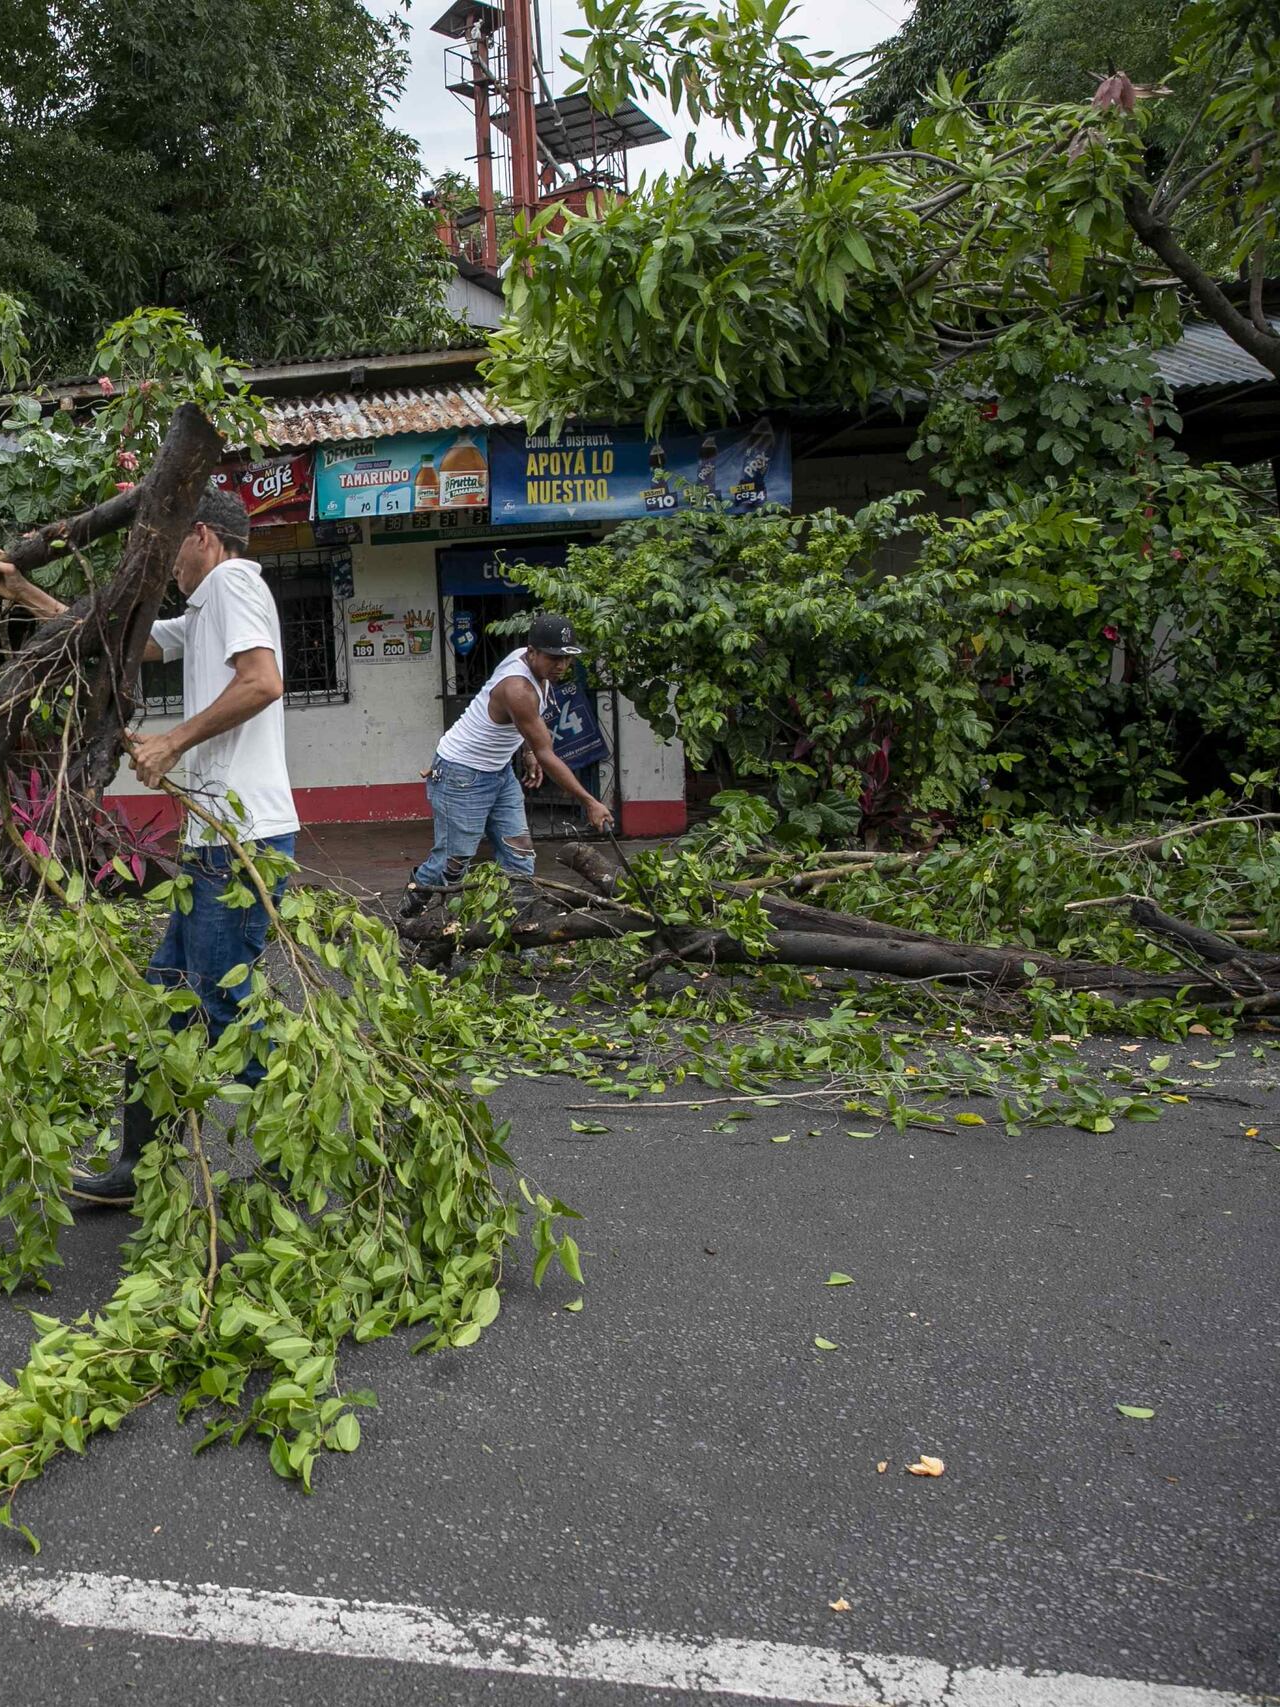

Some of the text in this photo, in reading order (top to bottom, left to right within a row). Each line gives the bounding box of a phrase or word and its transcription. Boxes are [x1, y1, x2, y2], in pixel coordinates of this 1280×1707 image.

[566, 433, 614, 447] DISFRUTÁ.
[526, 448, 614, 476] APOYÁ LO
[252, 463, 293, 498] Café
[339, 469, 410, 488] TAMARINDO
[527, 478, 615, 505] NUESTRO.
[361, 502, 371, 513] 10
[386, 500, 399, 511] 51
[356, 646, 373, 656] 189
[385, 645, 404, 655] 200
